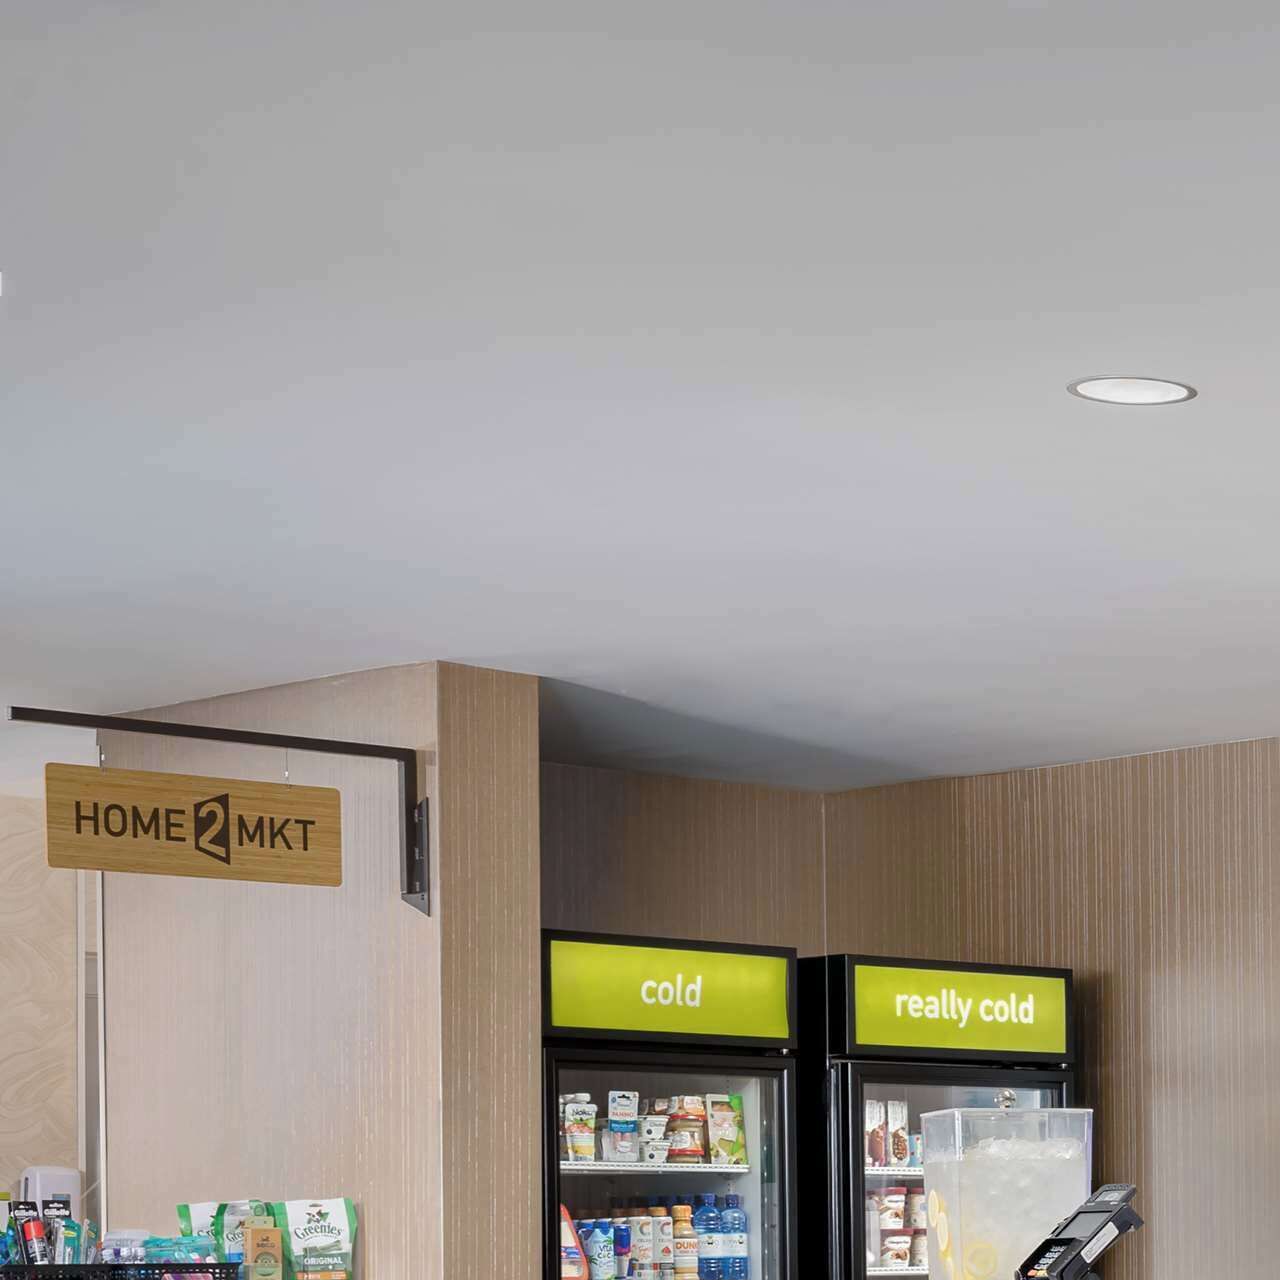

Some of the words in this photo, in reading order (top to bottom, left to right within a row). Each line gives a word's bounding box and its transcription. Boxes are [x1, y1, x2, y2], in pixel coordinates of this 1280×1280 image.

[75, 800, 187, 843] HOME
[237, 813, 316, 852] MKT
[640, 973, 702, 1008] cold
[894, 988, 974, 1029] really
[978, 993, 1035, 1026] cold
[293, 1221, 343, 1241] Greenies
[302, 1256, 343, 1267] ORIGINAL
